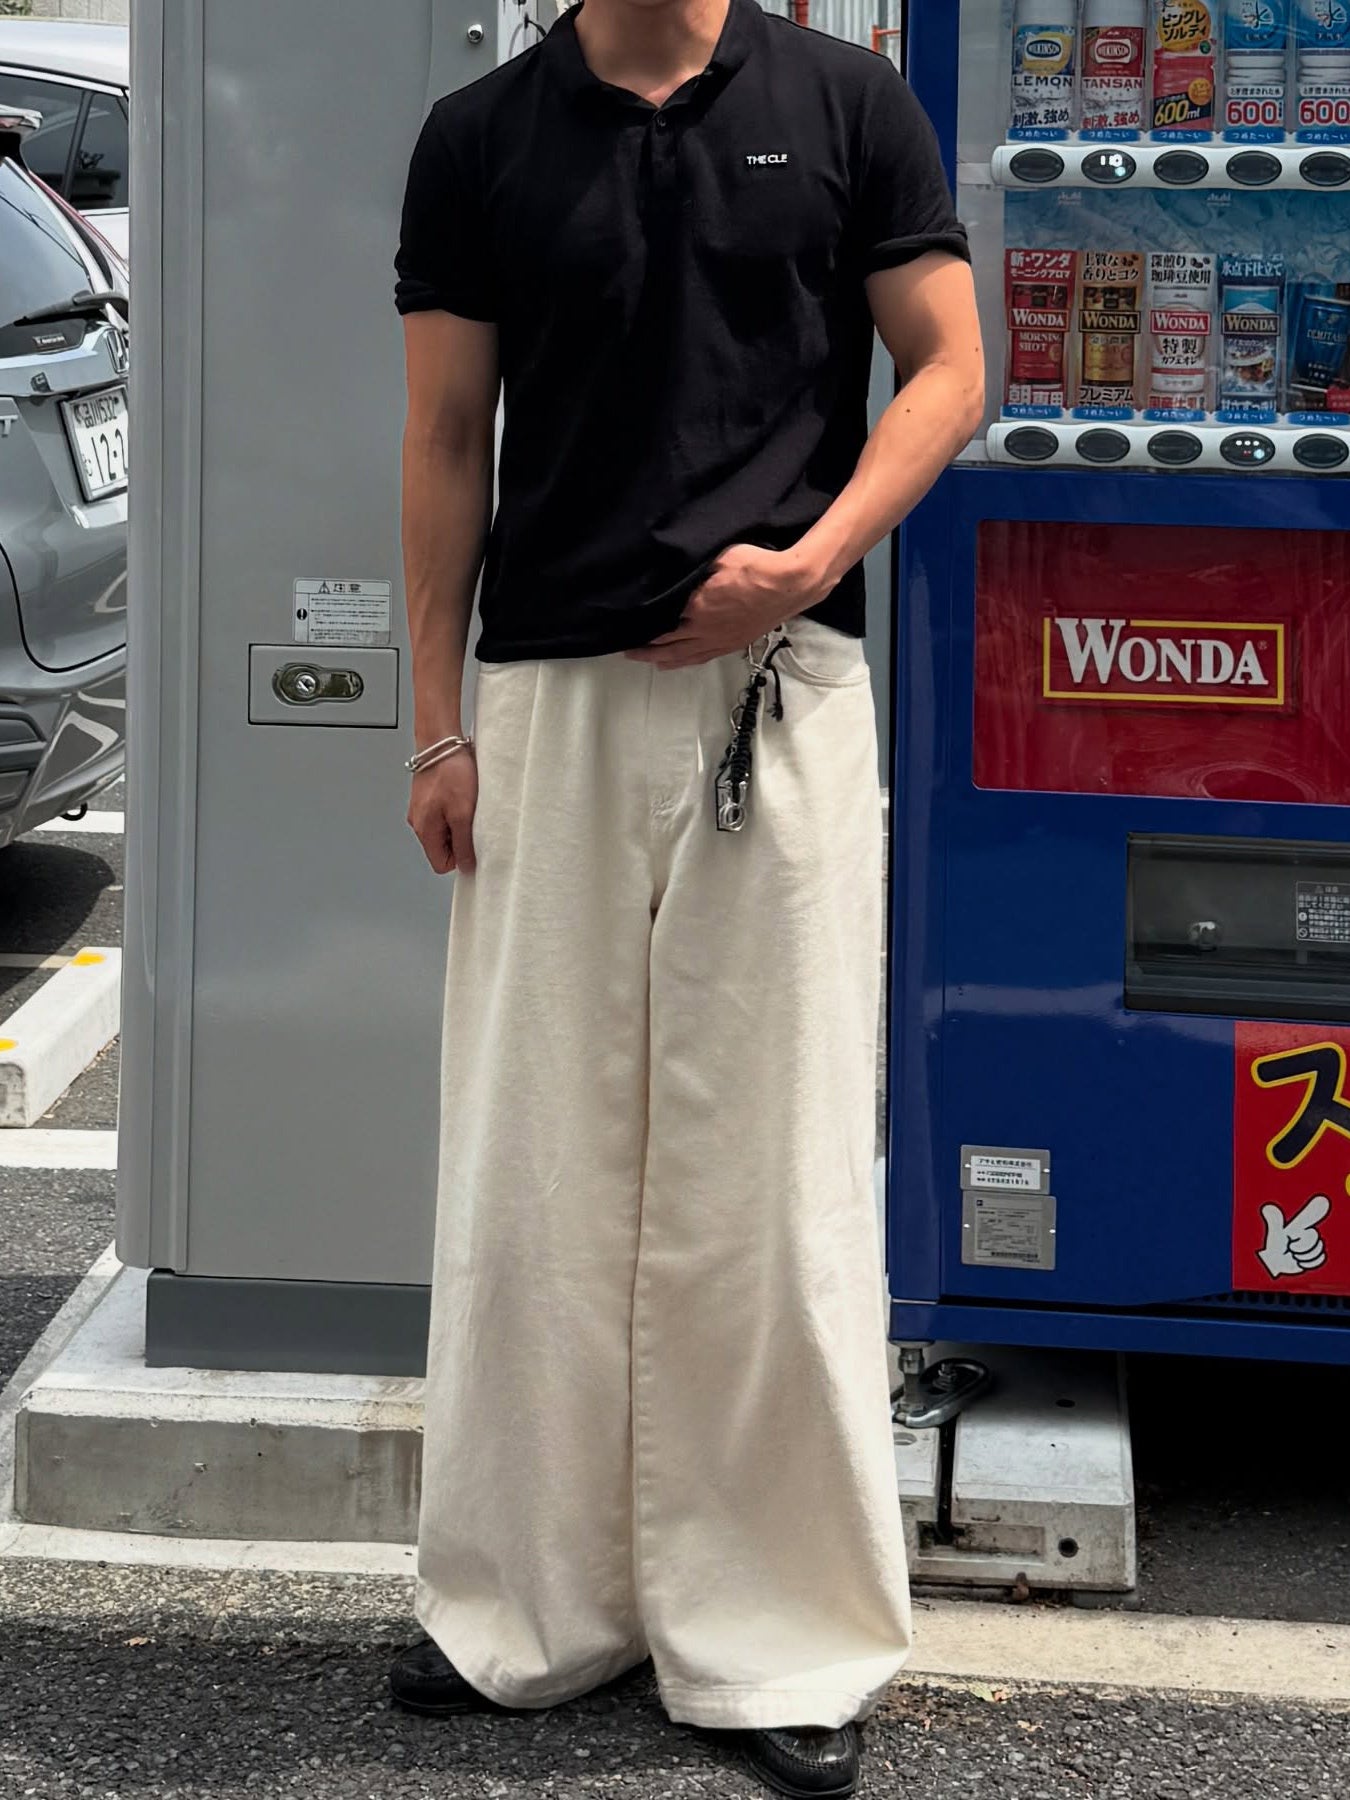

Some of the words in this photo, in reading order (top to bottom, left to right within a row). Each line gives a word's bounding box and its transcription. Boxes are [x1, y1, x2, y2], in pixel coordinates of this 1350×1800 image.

[1163, 25, 1207, 42] ソルティ
[1013, 76, 1073, 88] LEMON
[1083, 79, 1143, 89] TANSAN
[1227, 101, 1278, 125] 600
[1010, 250, 1072, 268] 新・ワンダ
[1085, 251, 1119, 267] 上質な
[1151, 254, 1186, 268] 深煎り
[1083, 268, 1139, 281] 香りとコク
[1151, 269, 1211, 285] 珈琲豆使用
[1221, 261, 1283, 277] 氷点下仕立て
[1012, 308, 1065, 326] WONDA
[1083, 310, 1135, 328] WONDA
[1154, 311, 1206, 330] WONDA
[1226, 313, 1276, 331] WONDA
[1018, 342, 1048, 352] SHOT
[1162, 337, 1197, 354] 特製
[1162, 356, 1198, 366] カフェオレ
[1054, 617, 1269, 685] WONDA
